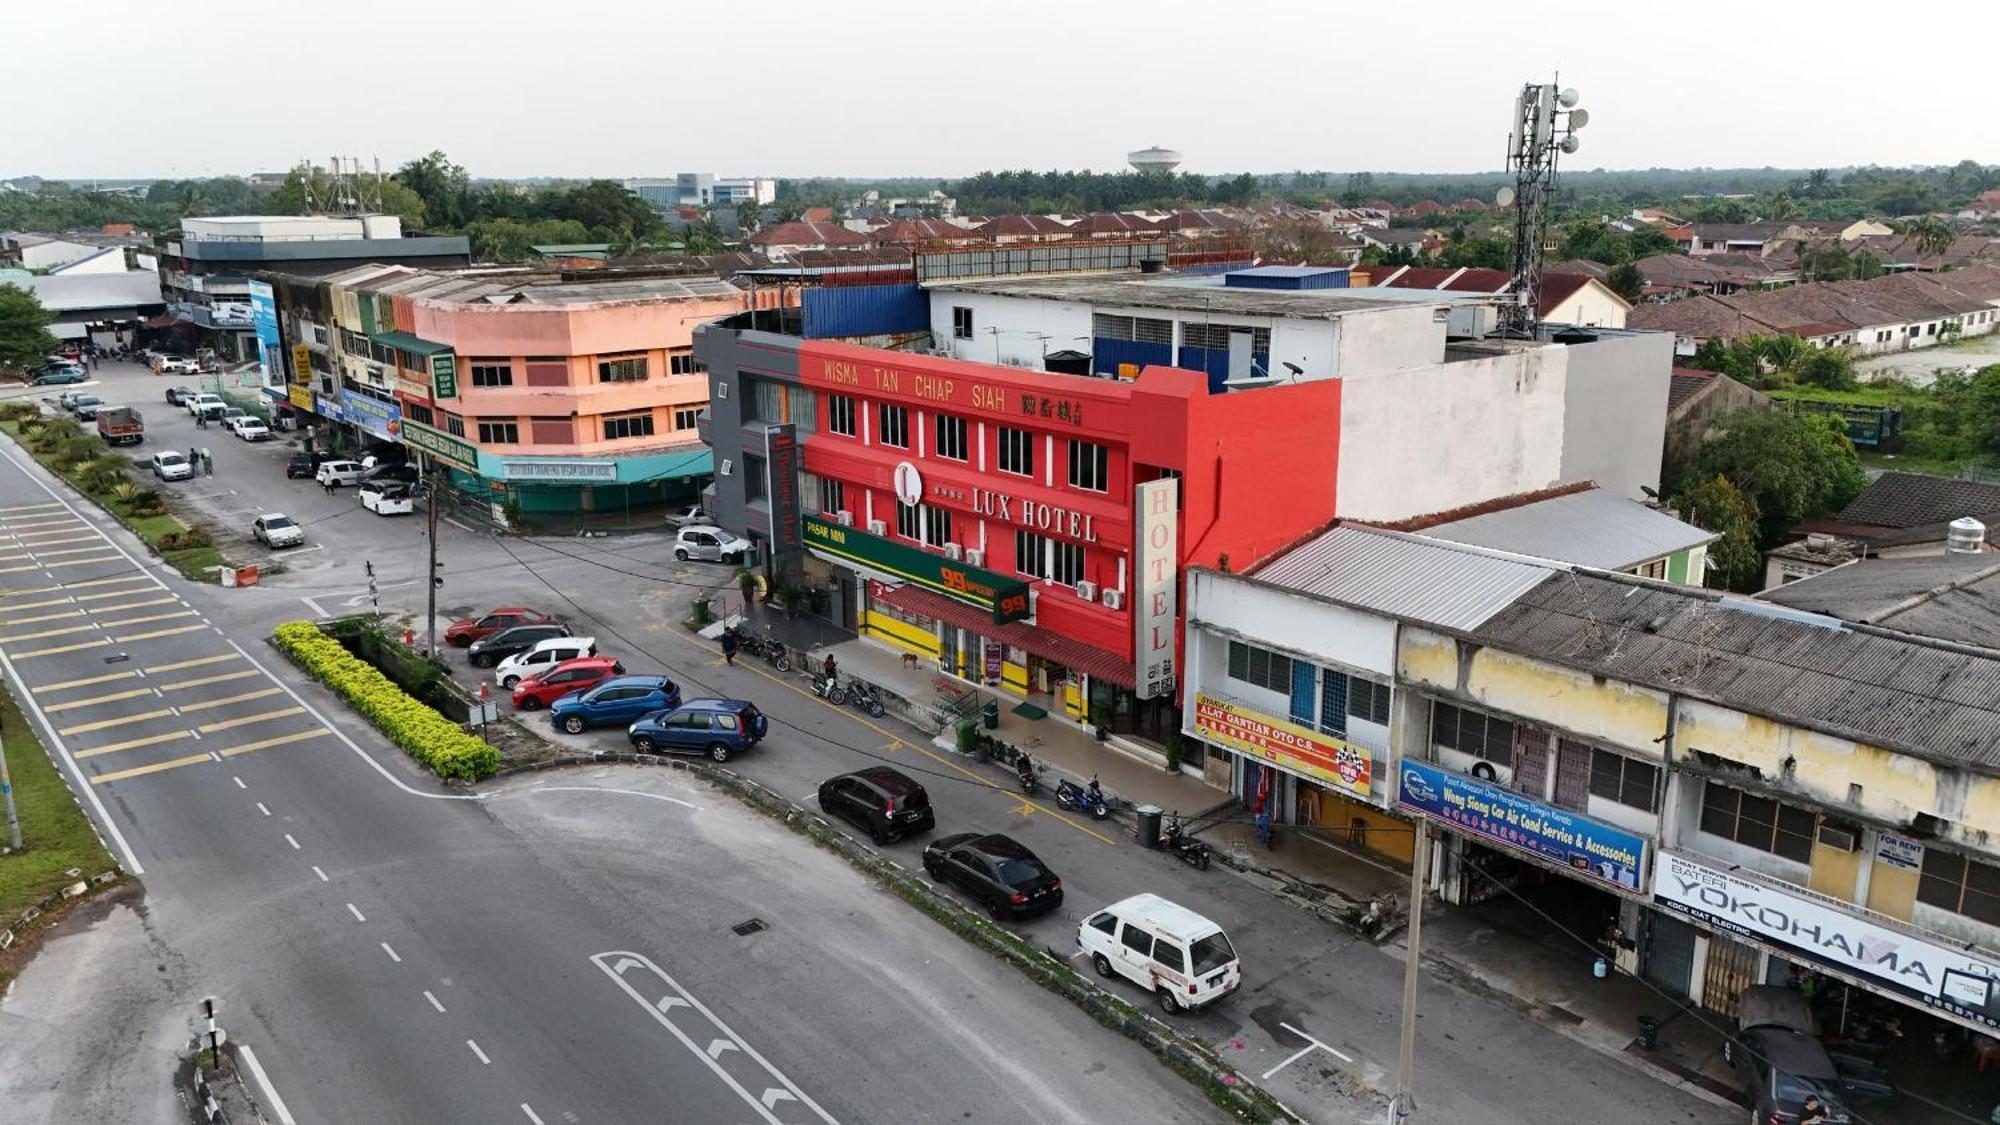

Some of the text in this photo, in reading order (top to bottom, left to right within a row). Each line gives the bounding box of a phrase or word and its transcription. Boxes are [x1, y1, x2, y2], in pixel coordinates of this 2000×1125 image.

[824, 360, 858, 385] WISMA
[874, 368, 898, 392] TAN
[915, 375, 953, 401] CHIAP
[972, 384, 1005, 412] SIAH
[972, 488, 1011, 521] LUX
[1023, 500, 1097, 542] HOTEL
[941, 567, 967, 592] 99
[1150, 488, 1169, 651] HOTEL
[1001, 595, 1025, 615] 99
[1200, 705, 1224, 720] ALAT
[1227, 713, 1270, 737] GANTIAN
[1272, 729, 1294, 744] OTO
[1443, 786, 1636, 867] Wong Siong Car Air Cond Service & Accessories
[1880, 835, 1921, 853] FOR RENT
[1671, 864, 1727, 891] BATERI
[1667, 900, 1689, 914] KOCK
[1711, 915, 1750, 937] ELECTRIC
[1672, 874, 1933, 986] YOKOHAMA
